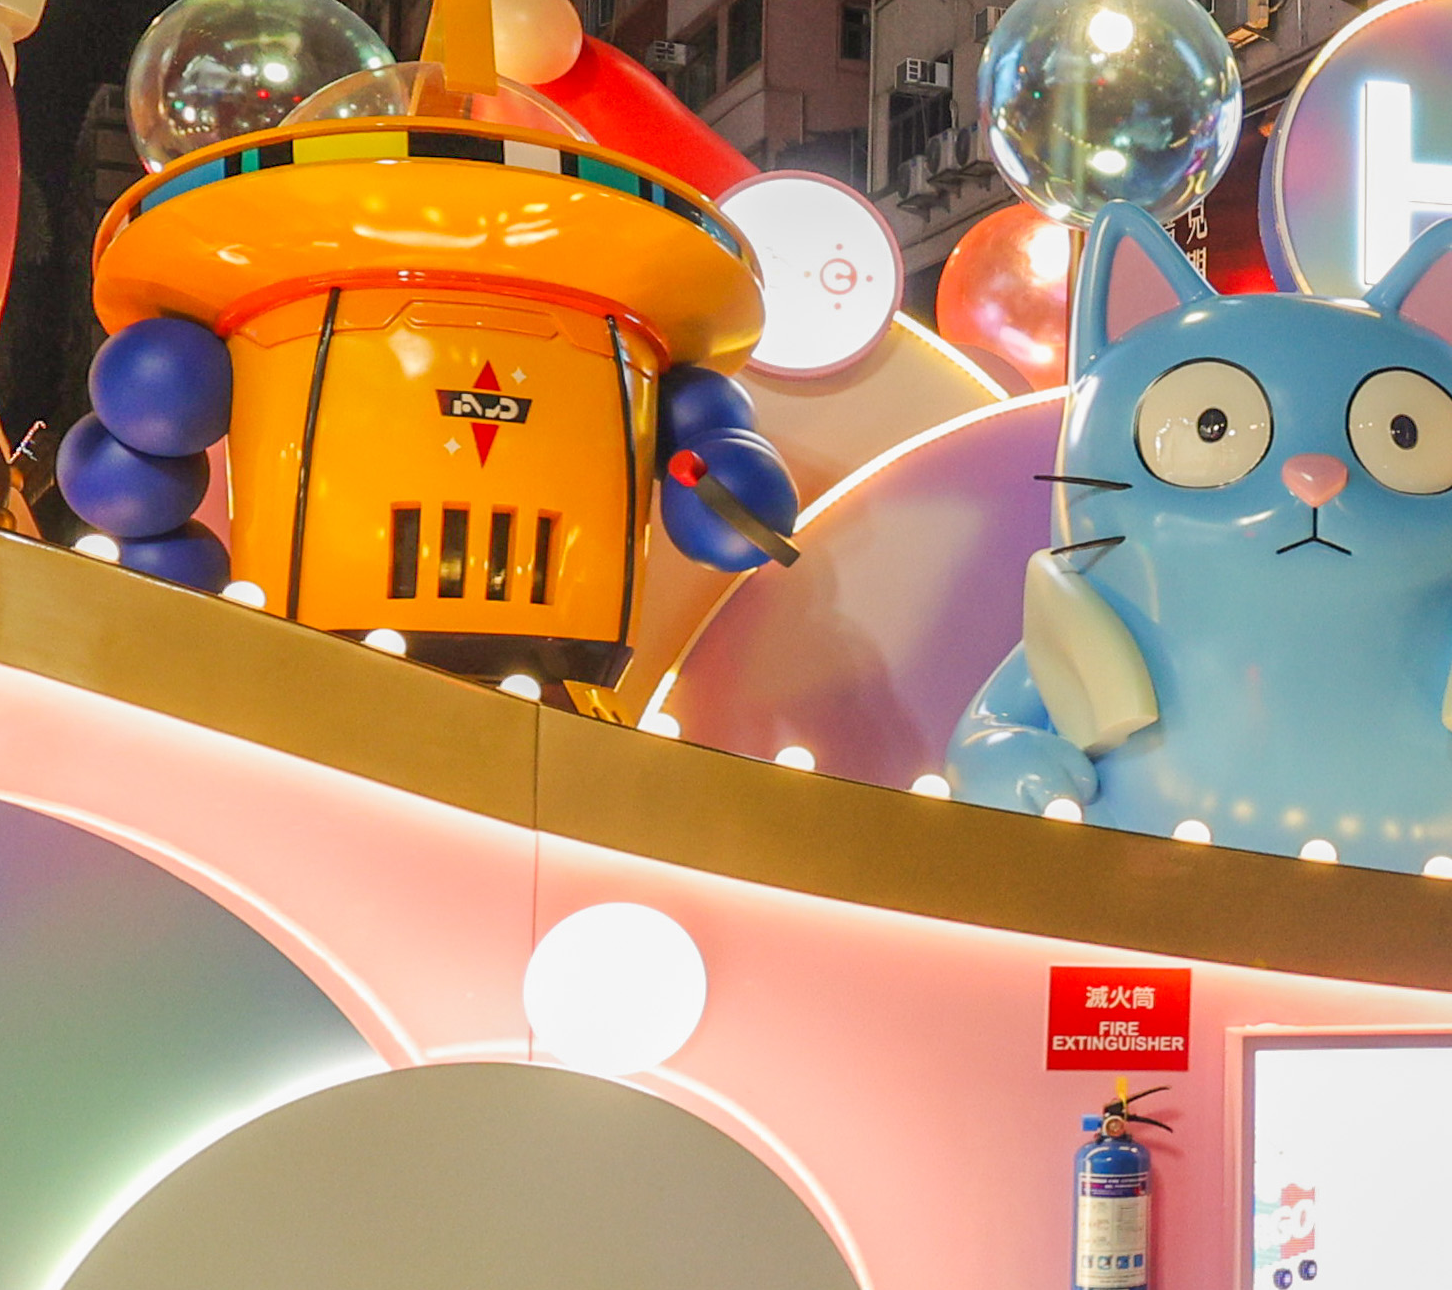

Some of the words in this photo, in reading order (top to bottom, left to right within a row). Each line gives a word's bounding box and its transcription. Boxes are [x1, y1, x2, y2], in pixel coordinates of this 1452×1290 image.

[1085, 985, 1156, 1010] 滅火筒
[1098, 1020, 1140, 1036] FIRE
[1051, 1035, 1185, 1051] EXTINGUISHER
